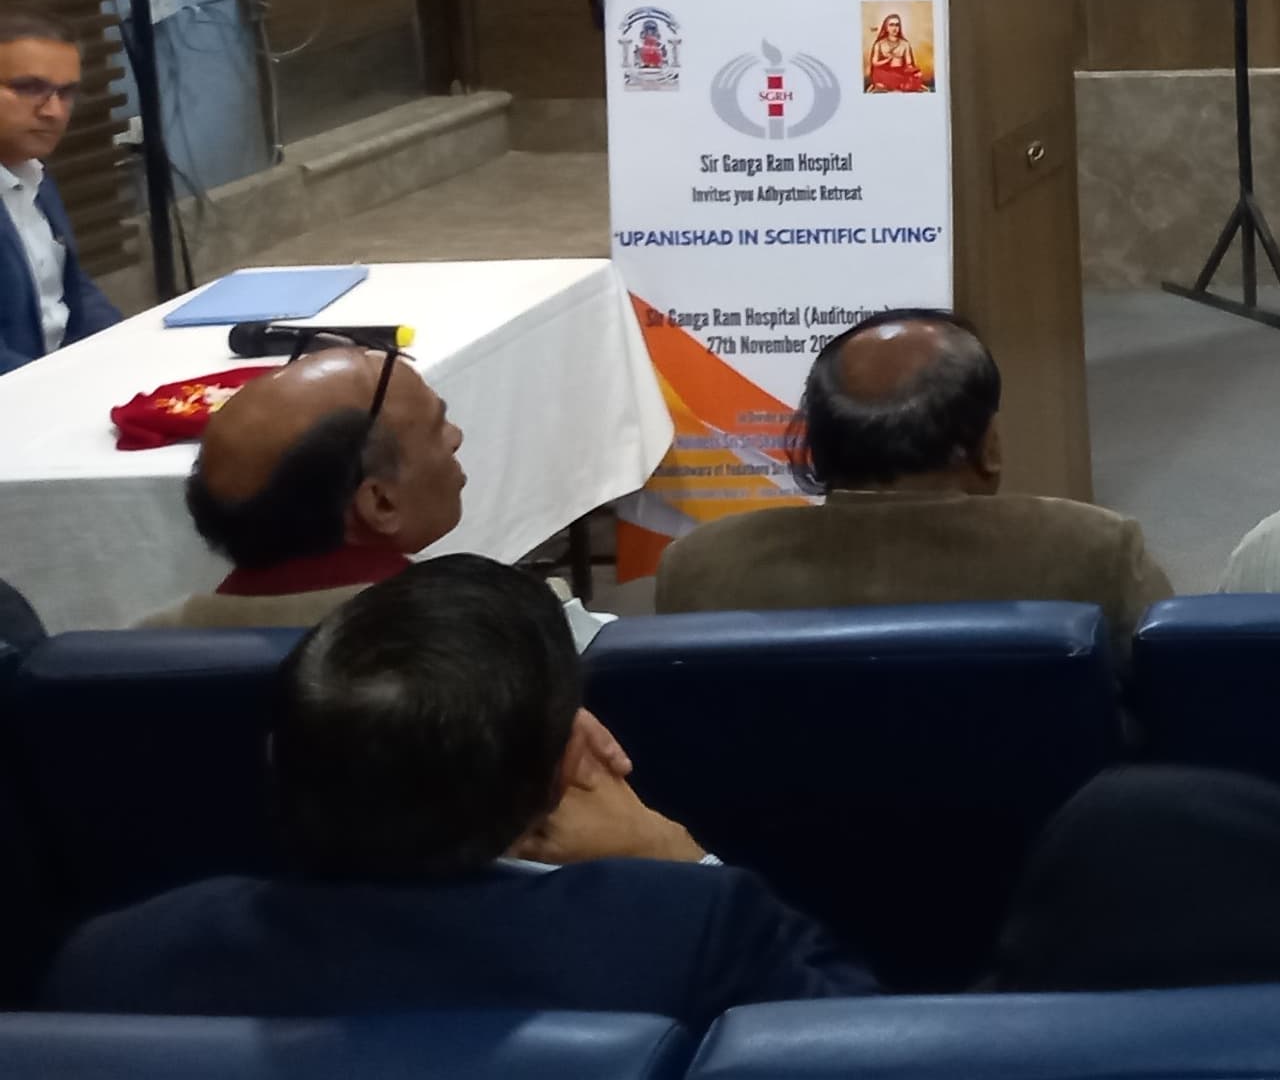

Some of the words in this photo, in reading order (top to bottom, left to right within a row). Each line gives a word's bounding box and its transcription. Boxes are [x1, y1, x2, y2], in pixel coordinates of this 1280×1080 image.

[700, 154, 719, 172] Sir
[722, 154, 763, 176] Ganga
[766, 154, 795, 172] Ram
[798, 152, 852, 175] Hospital
[692, 186, 731, 202] Invites
[733, 189, 754, 206] you
[819, 185, 863, 201] Retreat
[739, 229, 758, 245] IN
[764, 227, 866, 245] SCIENTIFIC
[668, 308, 709, 331] Ganga
[713, 308, 741, 326] Ram
[745, 307, 800, 330] Hospital
[707, 336, 736, 354] 27th
[740, 335, 808, 354] November
